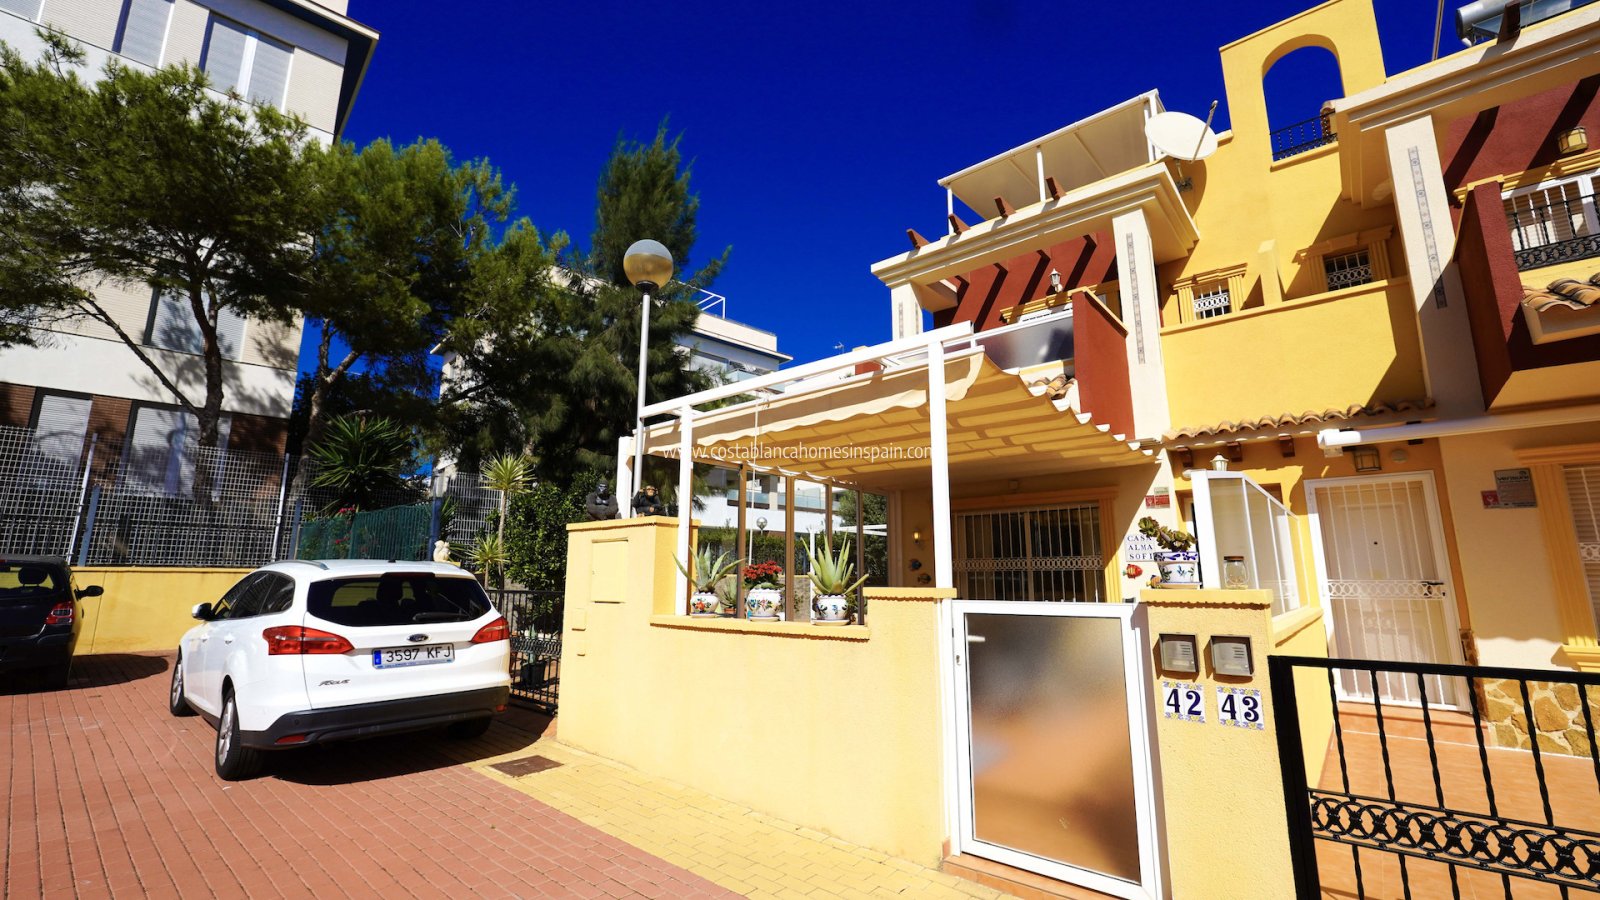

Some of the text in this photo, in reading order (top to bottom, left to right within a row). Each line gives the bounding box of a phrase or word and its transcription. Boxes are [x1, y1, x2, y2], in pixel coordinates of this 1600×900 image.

[386, 645, 451, 663] 3597 KFJ
[1166, 688, 1202, 716] 42
[1221, 694, 1260, 723] 43
